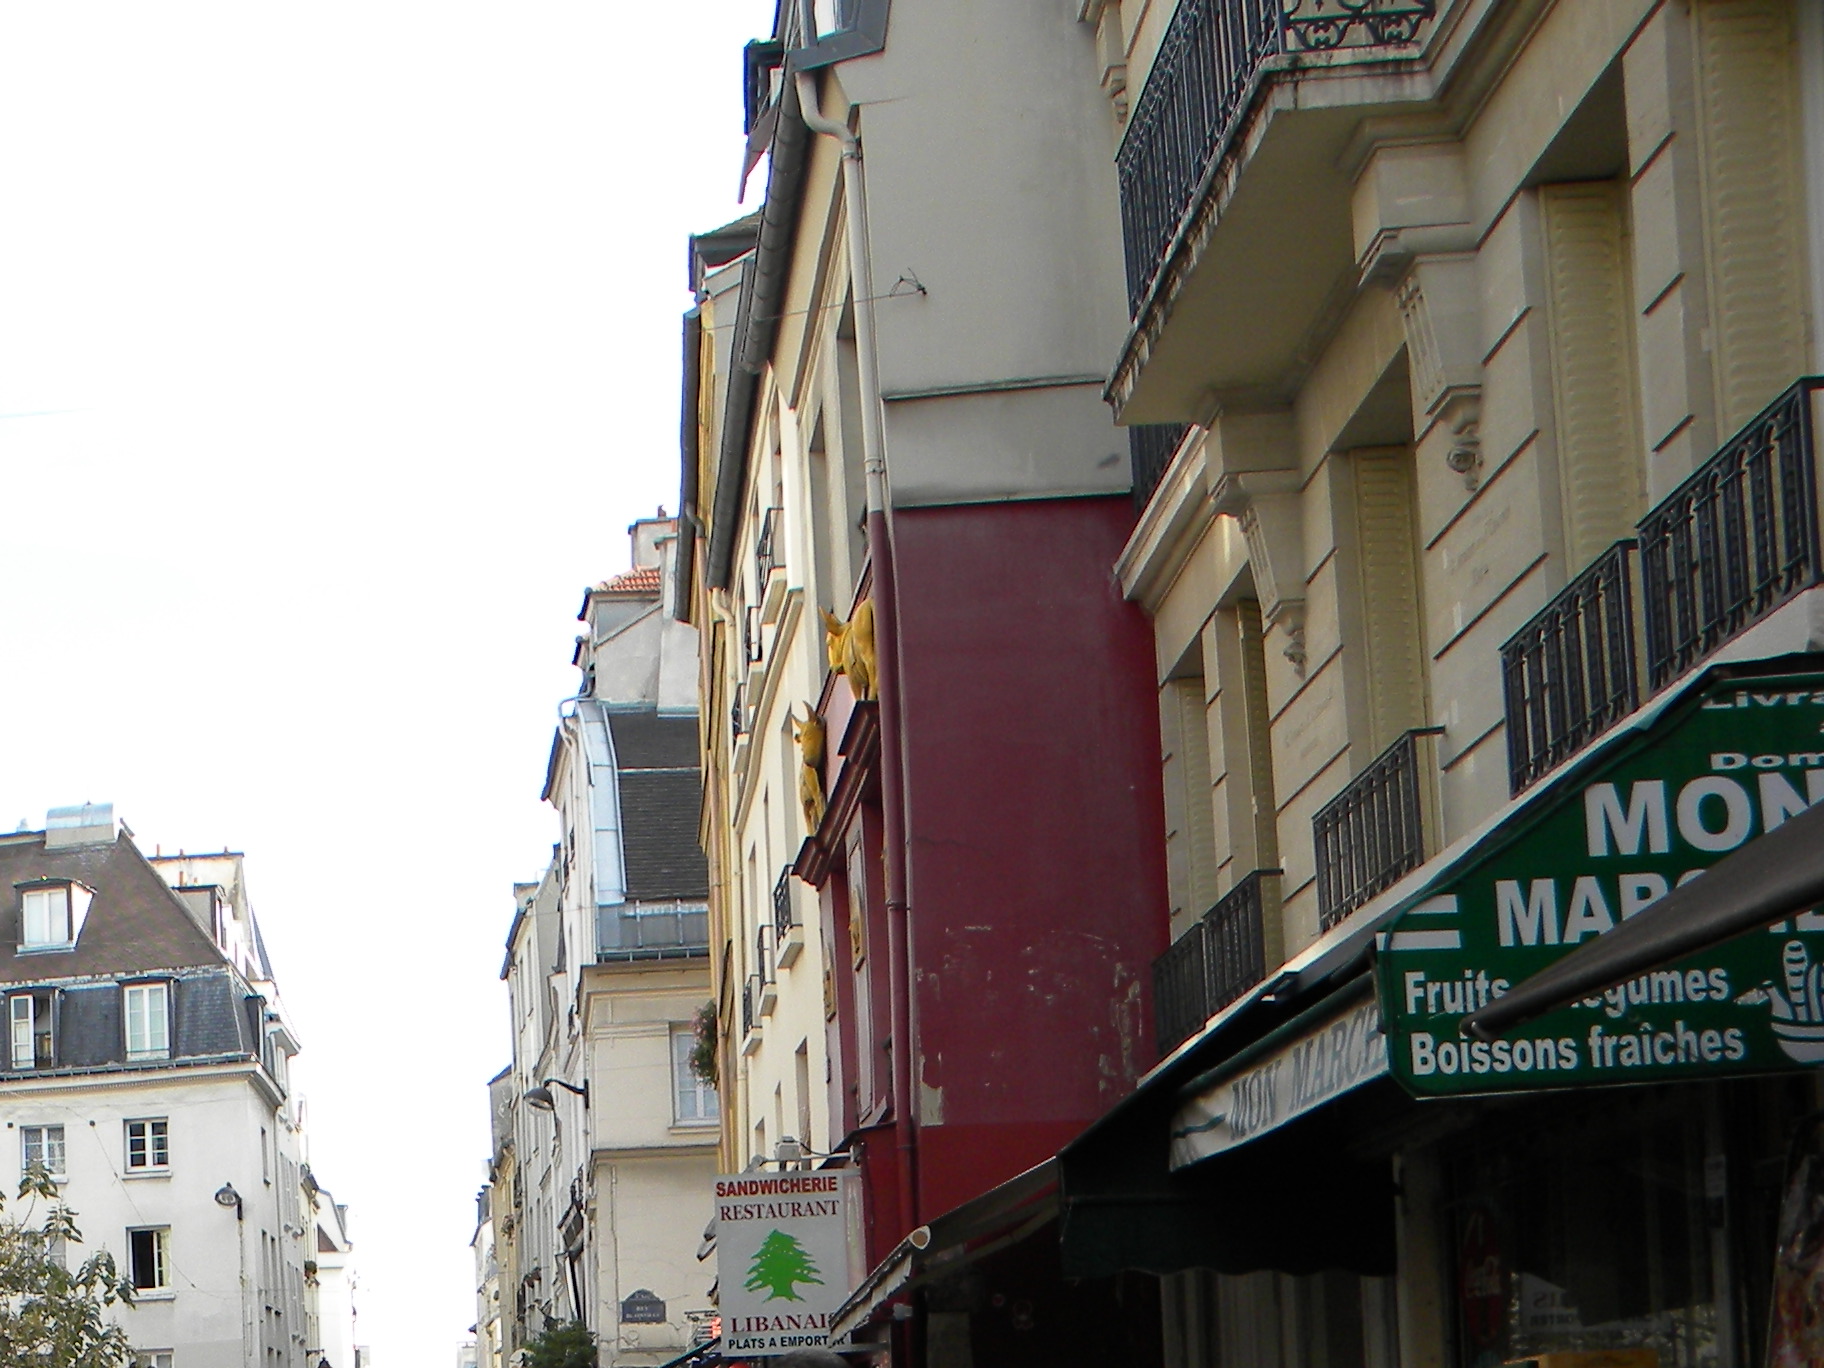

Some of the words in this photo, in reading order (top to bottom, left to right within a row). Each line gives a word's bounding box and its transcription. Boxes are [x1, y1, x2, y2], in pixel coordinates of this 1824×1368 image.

[1410, 1031, 1578, 1077] Boissons
[1589, 1020, 1745, 1068] fraîches
[1230, 1059, 1282, 1141] MON
[716, 1176, 838, 1198] SANDWICHERIE
[720, 1200, 840, 1222] RESTAURANT
[728, 1338, 765, 1350] PLATS
[768, 1337, 777, 1348] A
